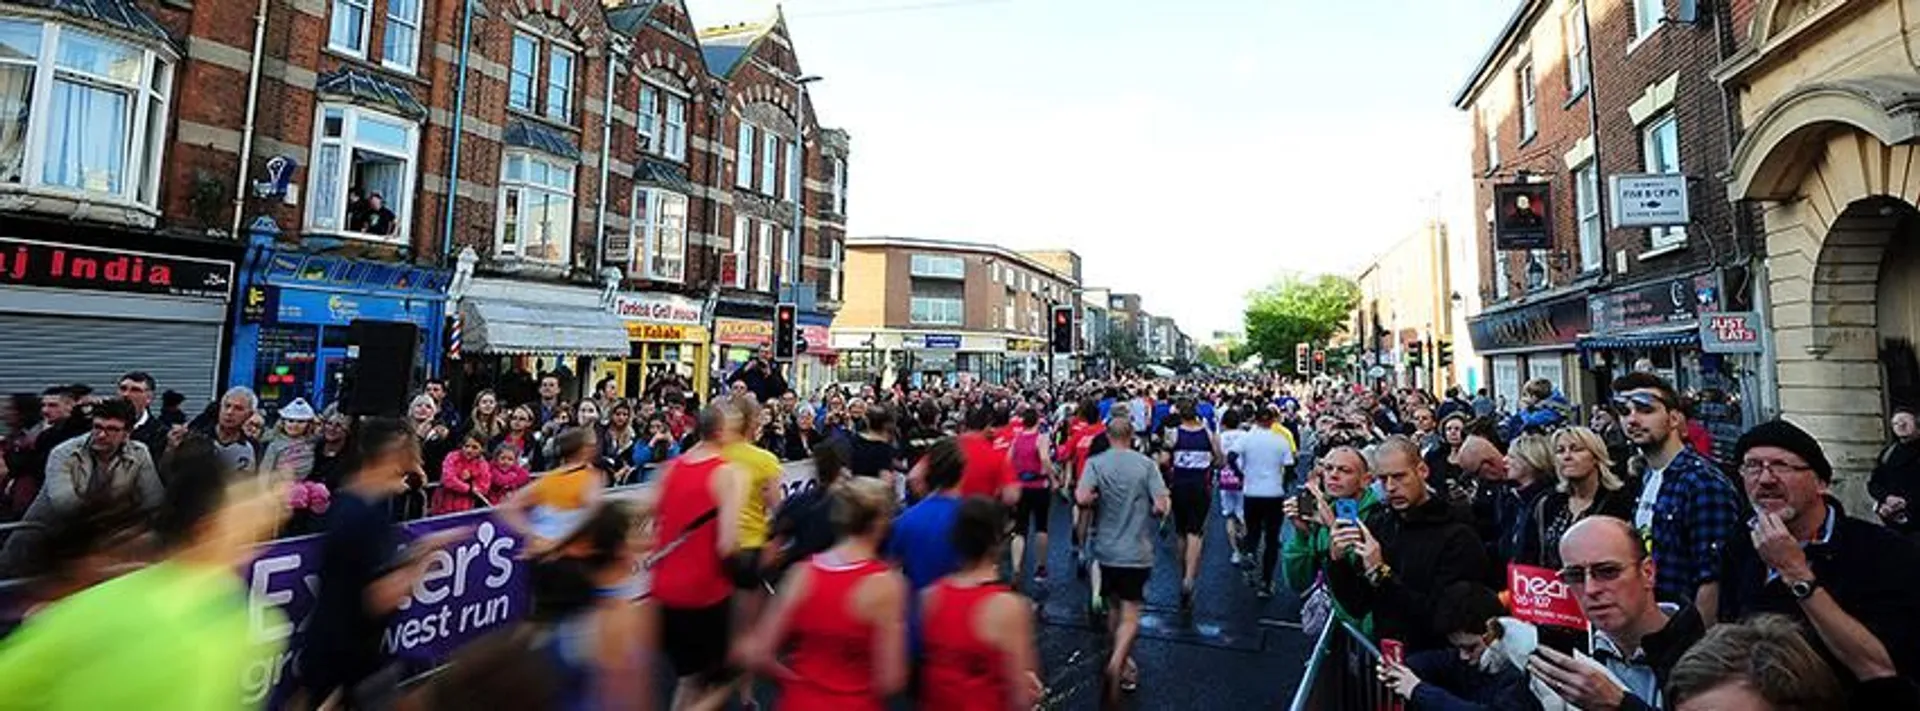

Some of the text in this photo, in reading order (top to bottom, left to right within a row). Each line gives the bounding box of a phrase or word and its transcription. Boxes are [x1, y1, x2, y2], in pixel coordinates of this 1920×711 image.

[51, 250, 171, 285] India
[1710, 316, 1745, 330] JUST
[1512, 568, 1570, 600] hear
[381, 609, 452, 654] west
[458, 594, 509, 633] run
